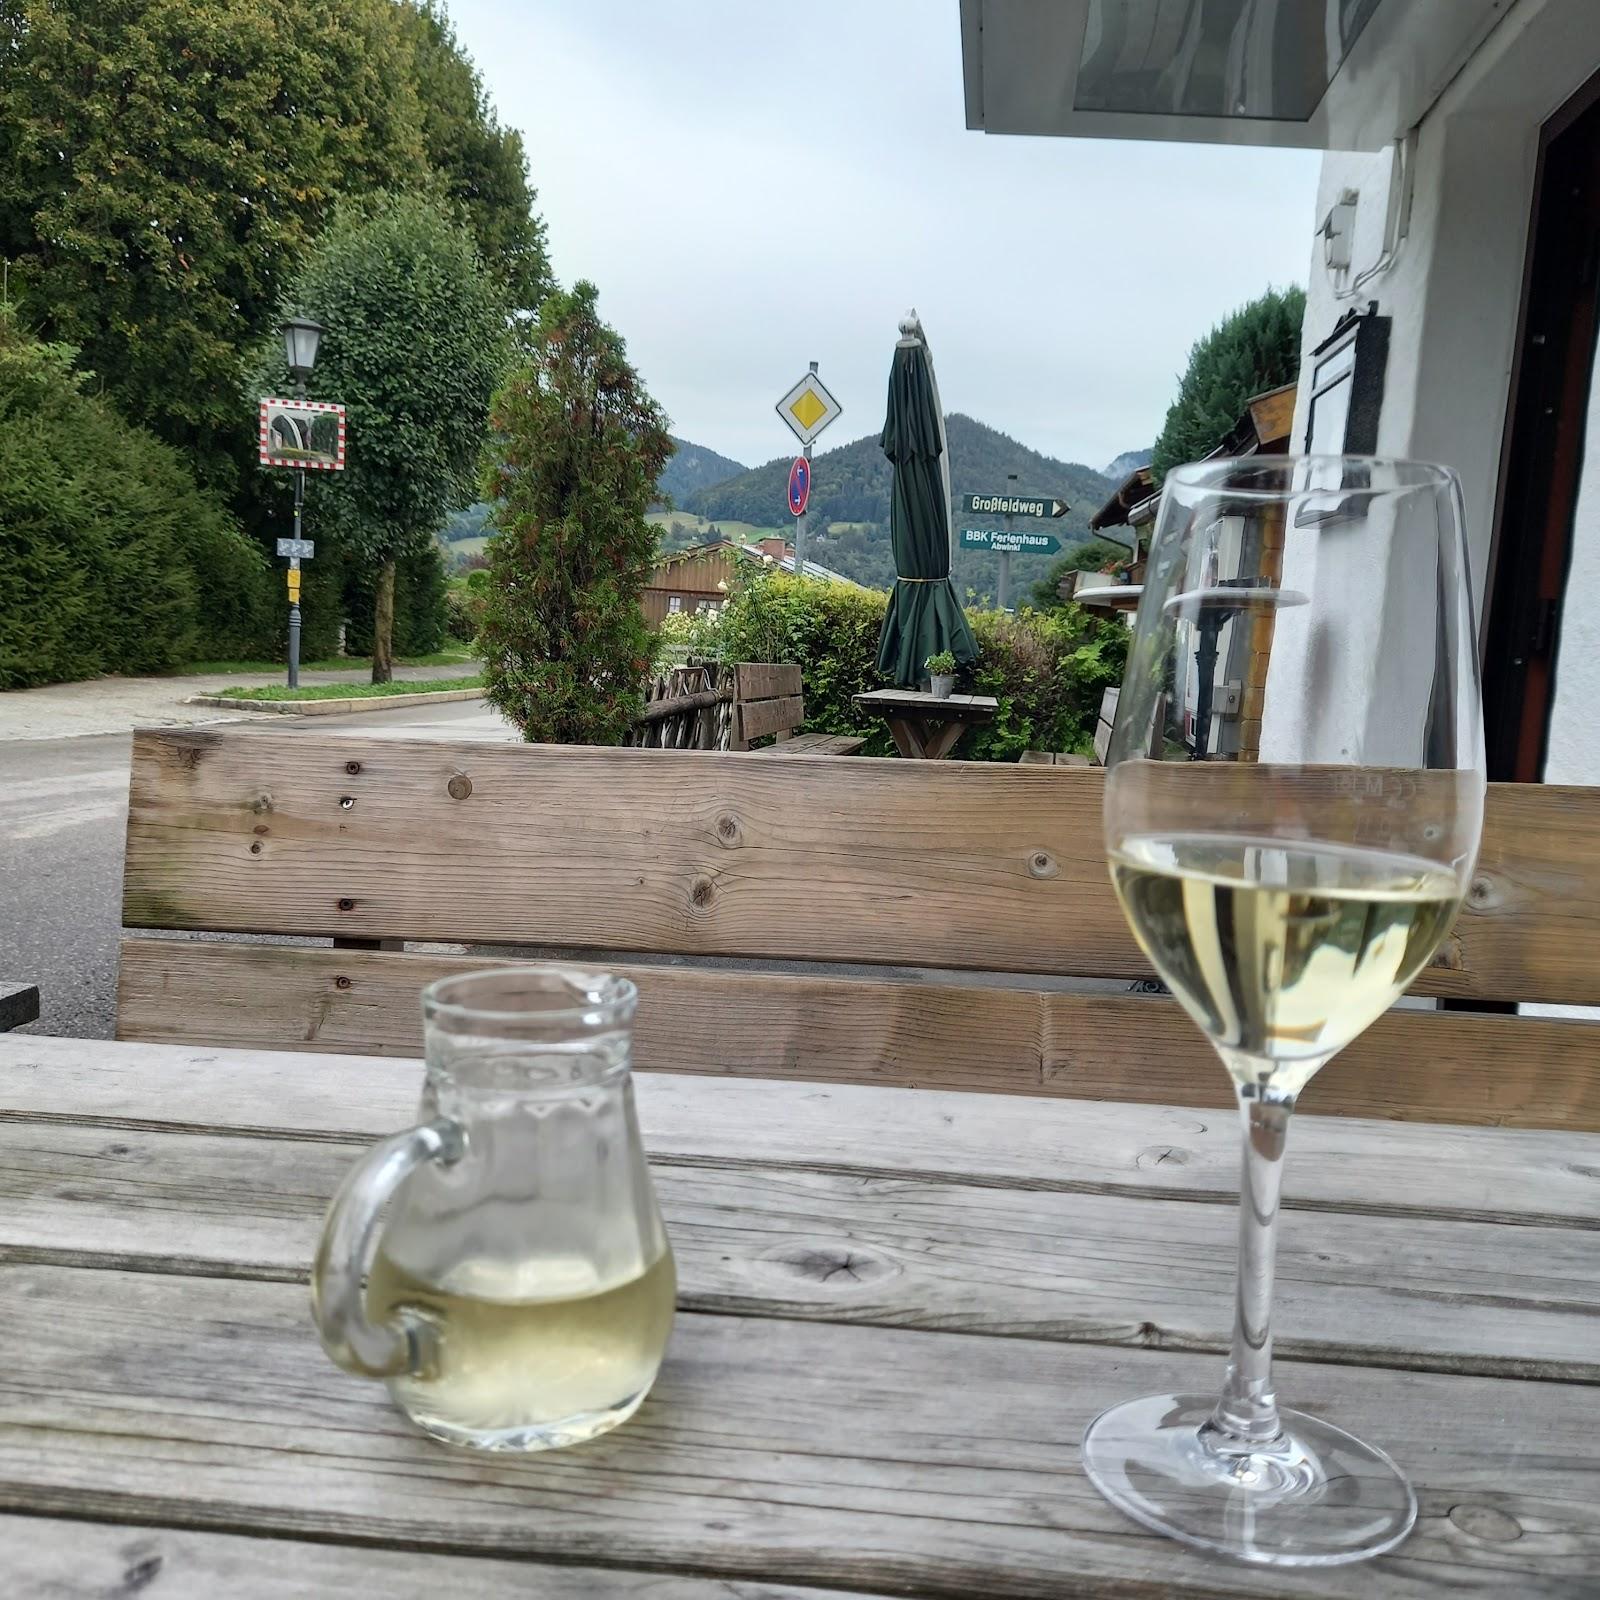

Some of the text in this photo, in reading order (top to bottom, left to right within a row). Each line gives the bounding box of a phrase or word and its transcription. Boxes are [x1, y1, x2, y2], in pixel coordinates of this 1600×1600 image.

[972, 496, 1044, 517] Großfeldweg
[966, 530, 1048, 545] BBK Ferienhaus
[991, 542, 1021, 551] Abwinkl
